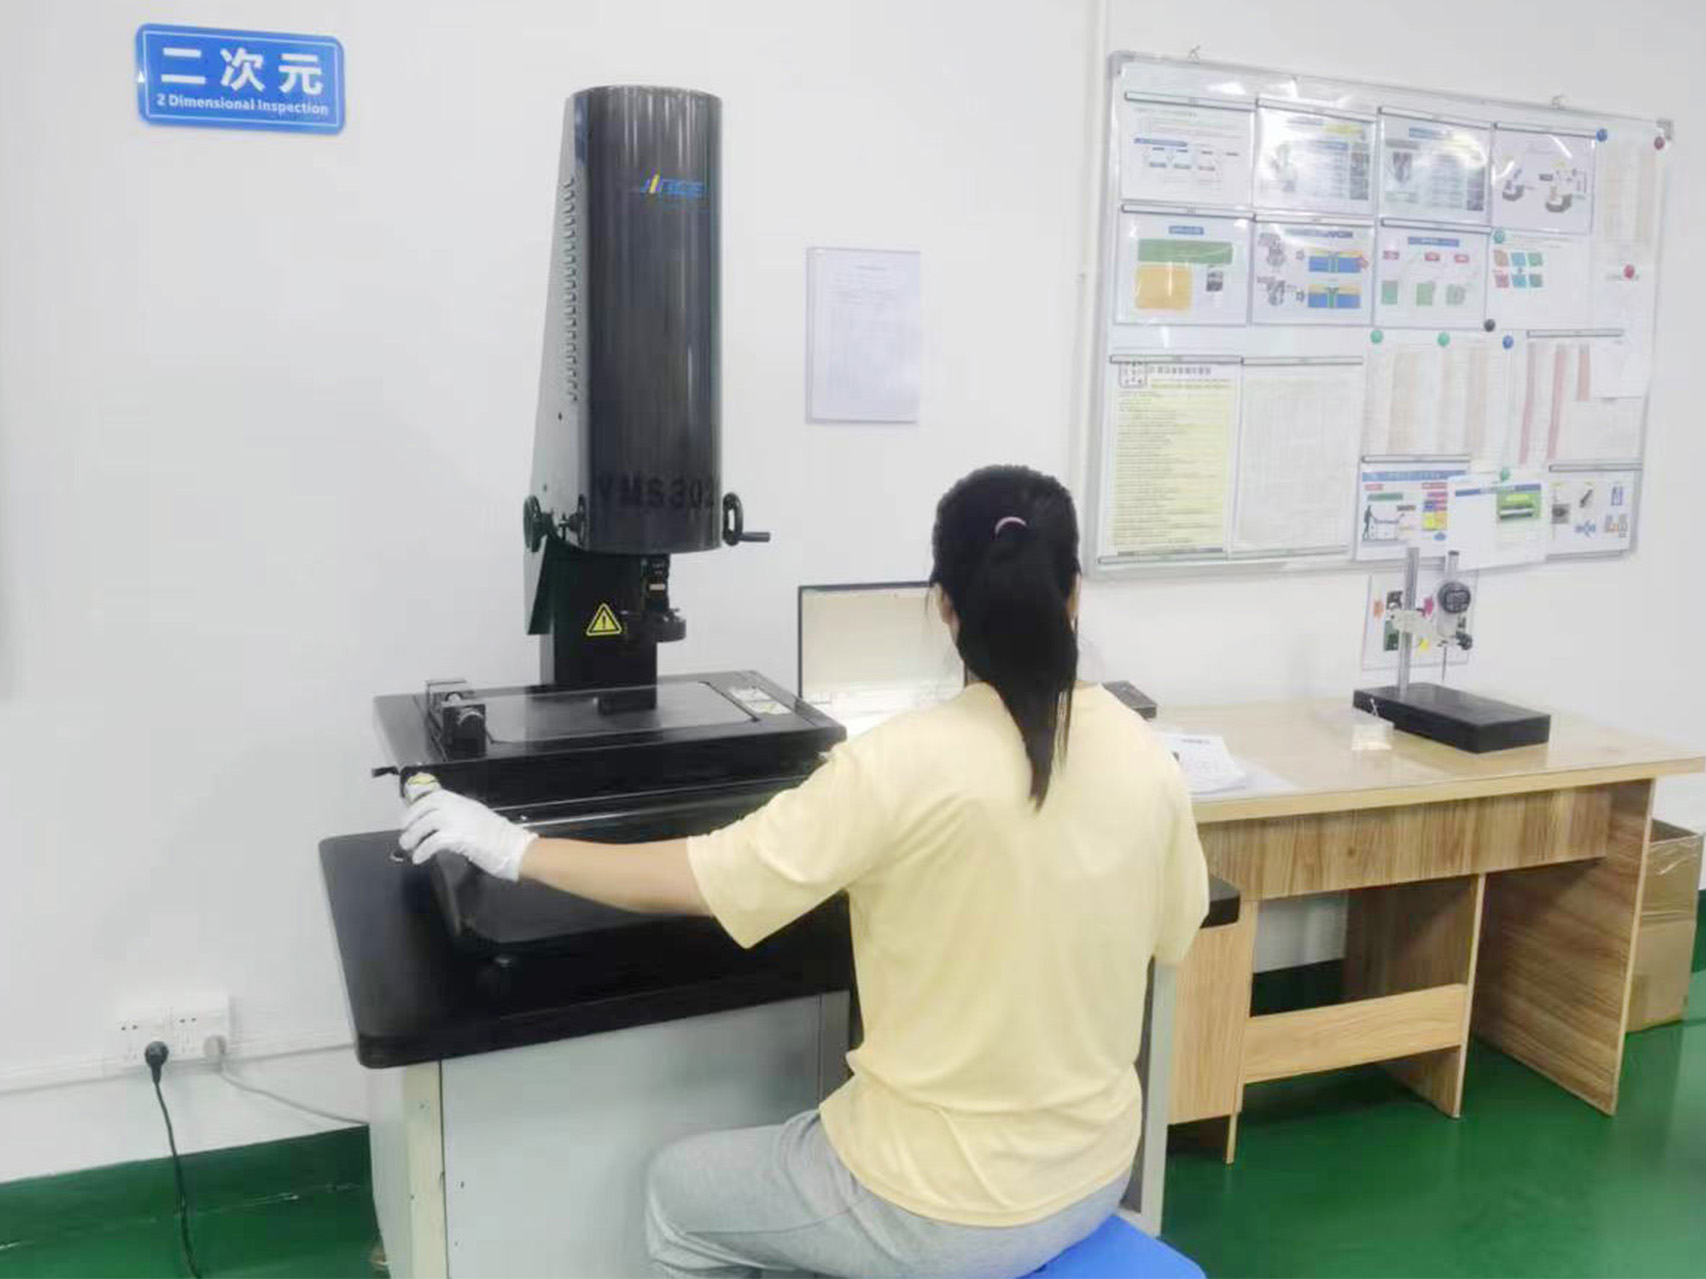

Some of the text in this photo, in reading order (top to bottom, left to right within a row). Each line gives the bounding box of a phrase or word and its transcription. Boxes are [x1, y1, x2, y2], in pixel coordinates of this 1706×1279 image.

[160, 46, 323, 96] 二次元
[156, 93, 330, 116] 2 Dimensional Inspection
